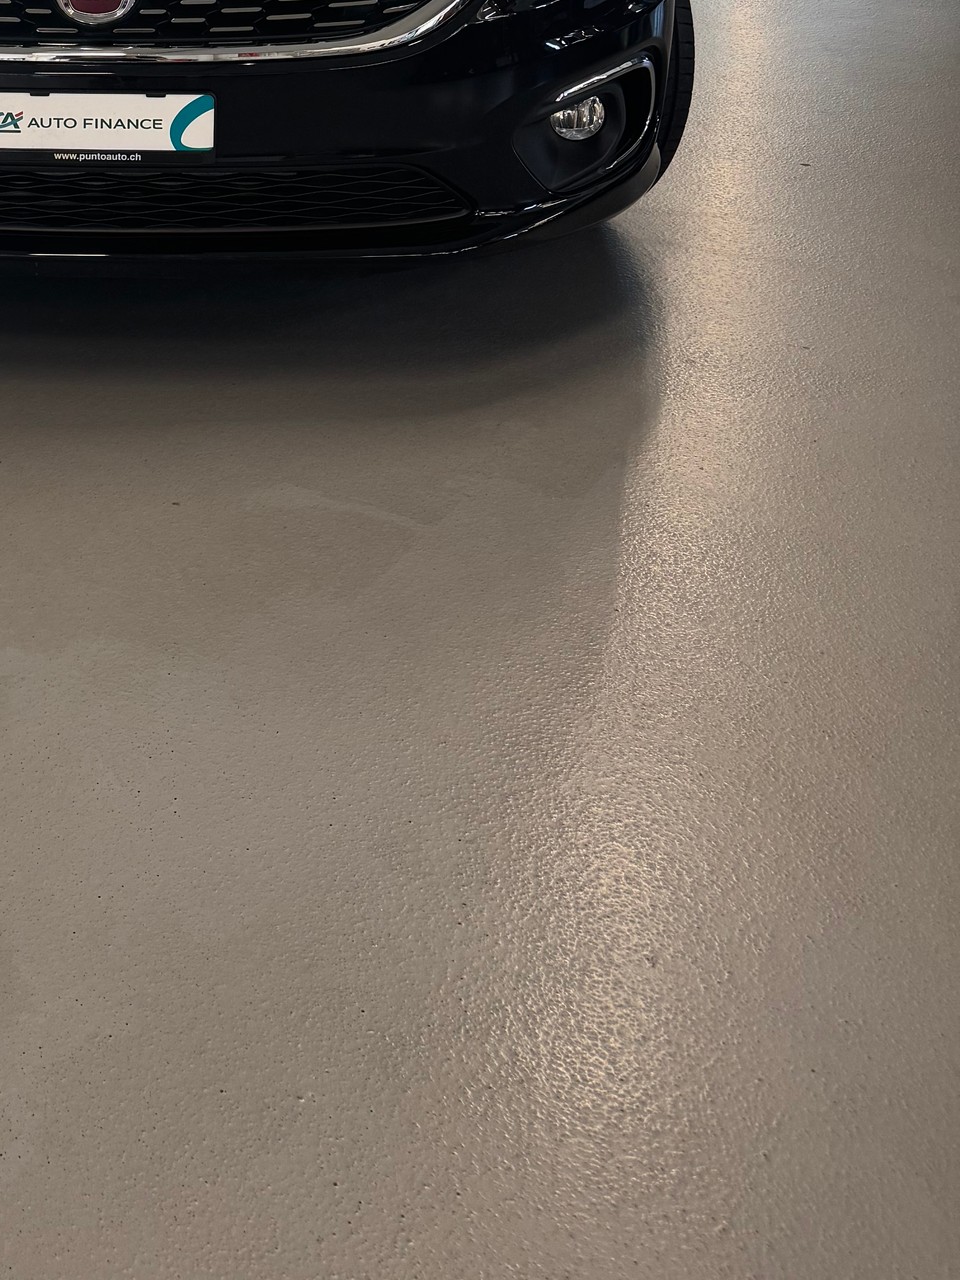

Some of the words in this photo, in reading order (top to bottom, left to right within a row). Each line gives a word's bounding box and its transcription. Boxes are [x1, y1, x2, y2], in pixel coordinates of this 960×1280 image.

[27, 117, 77, 129] AUTO
[83, 118, 163, 130] FINANCE
[53, 152, 142, 162] www.puntoauto.ch
